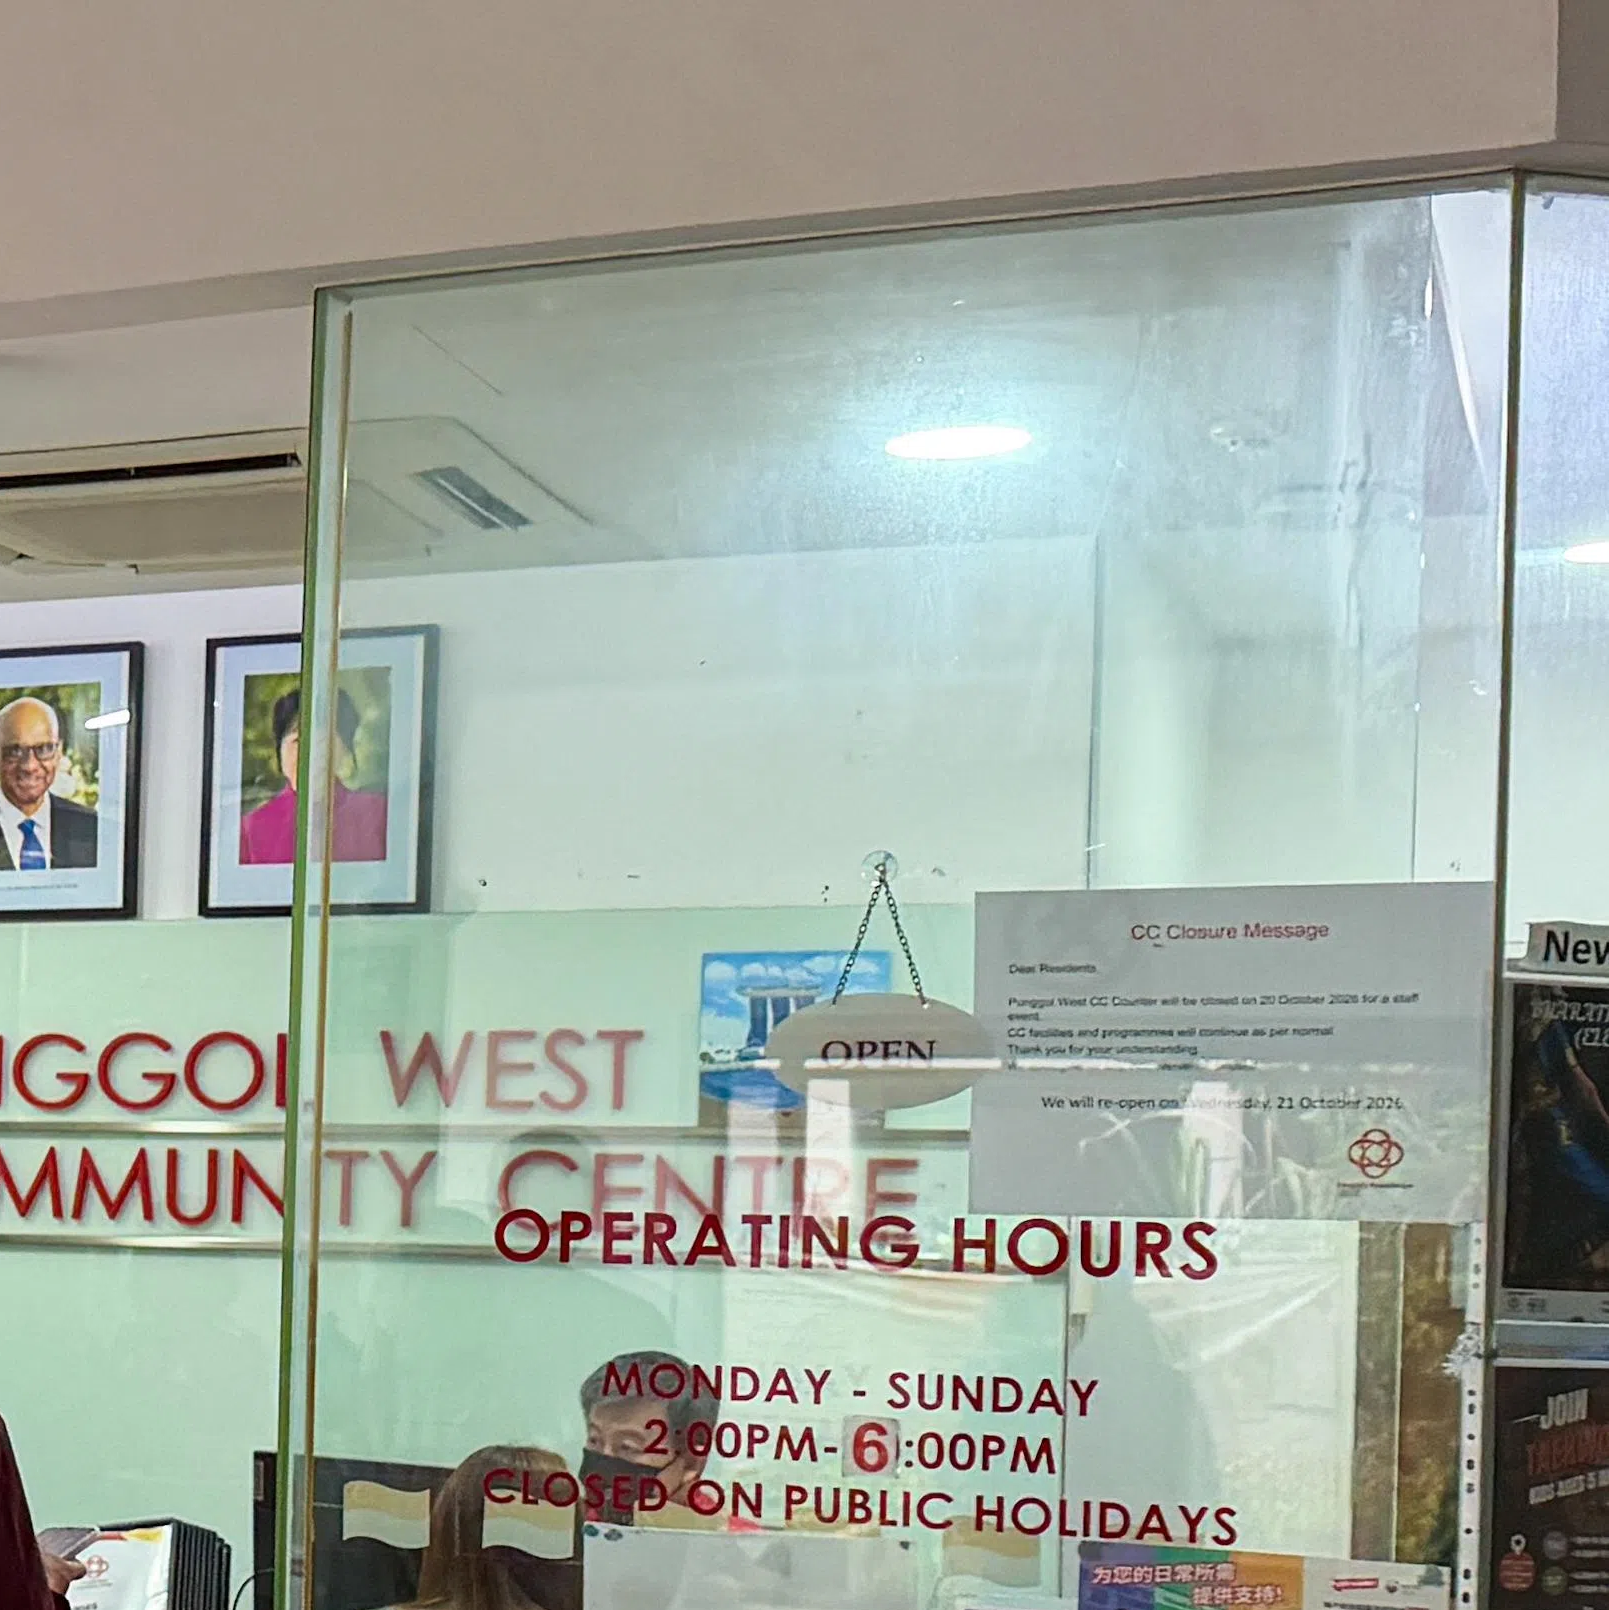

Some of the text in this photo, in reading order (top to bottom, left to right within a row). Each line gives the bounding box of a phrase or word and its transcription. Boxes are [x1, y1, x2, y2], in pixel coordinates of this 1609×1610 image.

[1131, 923, 1330, 941] CC Closure Message
[821, 1040, 937, 1064] OPEN
[1008, 1028, 1026, 1038] CC
[380, 1029, 644, 1111] WEST
[1042, 1096, 1065, 1109] We
[1069, 1096, 1094, 1109] will
[1098, 1097, 1155, 1112] re-open
[1277, 1097, 1294, 1109] 21
[1300, 1096, 1360, 1109] October
[497, 1149, 921, 1235] CENTRE
[495, 1209, 1218, 1280] OPERATING HOURS
[602, 1362, 832, 1405] MONDAY
[887, 1372, 1099, 1416] SUNDAY
[1539, 1388, 1589, 1429] JOIN
[483, 1468, 1238, 1546] CLOSED ON PUBLIC HOLIDAYS
